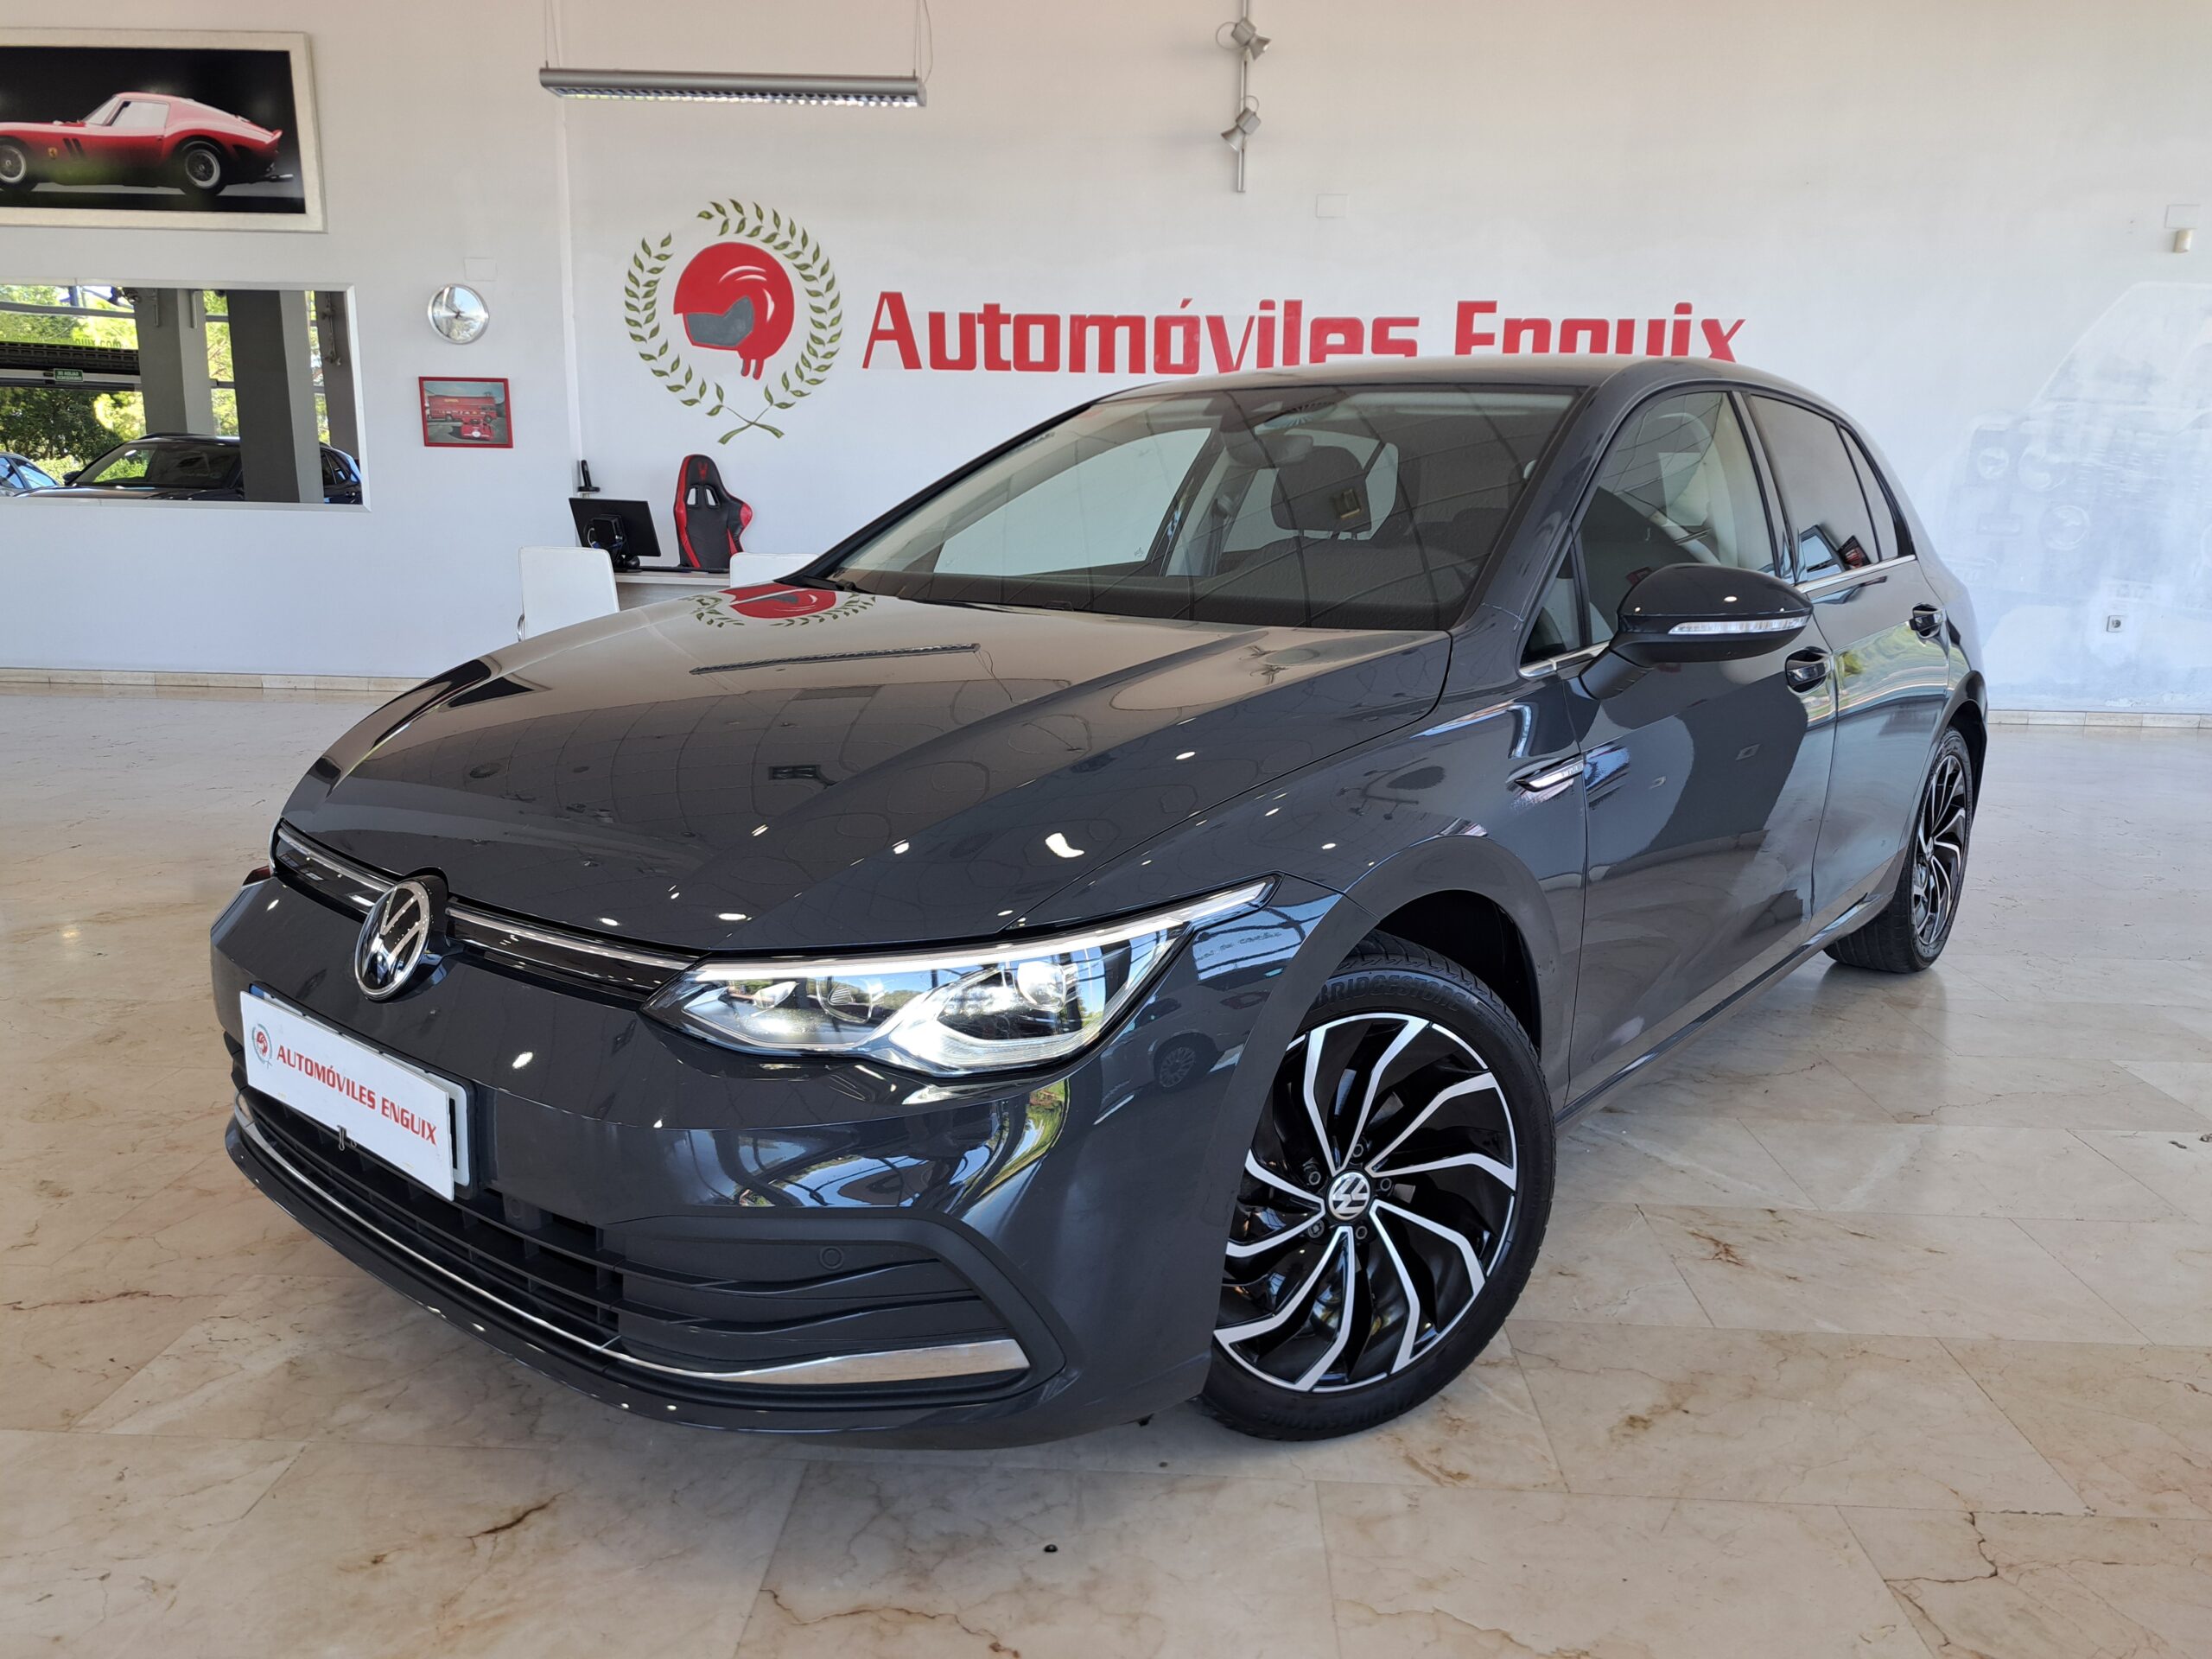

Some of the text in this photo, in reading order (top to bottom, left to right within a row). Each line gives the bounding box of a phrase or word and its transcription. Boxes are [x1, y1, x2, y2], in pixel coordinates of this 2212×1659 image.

[862, 291, 1419, 374] Automóviles
[276, 1044, 437, 1147] AUTOMÓVILES ENGUIX
